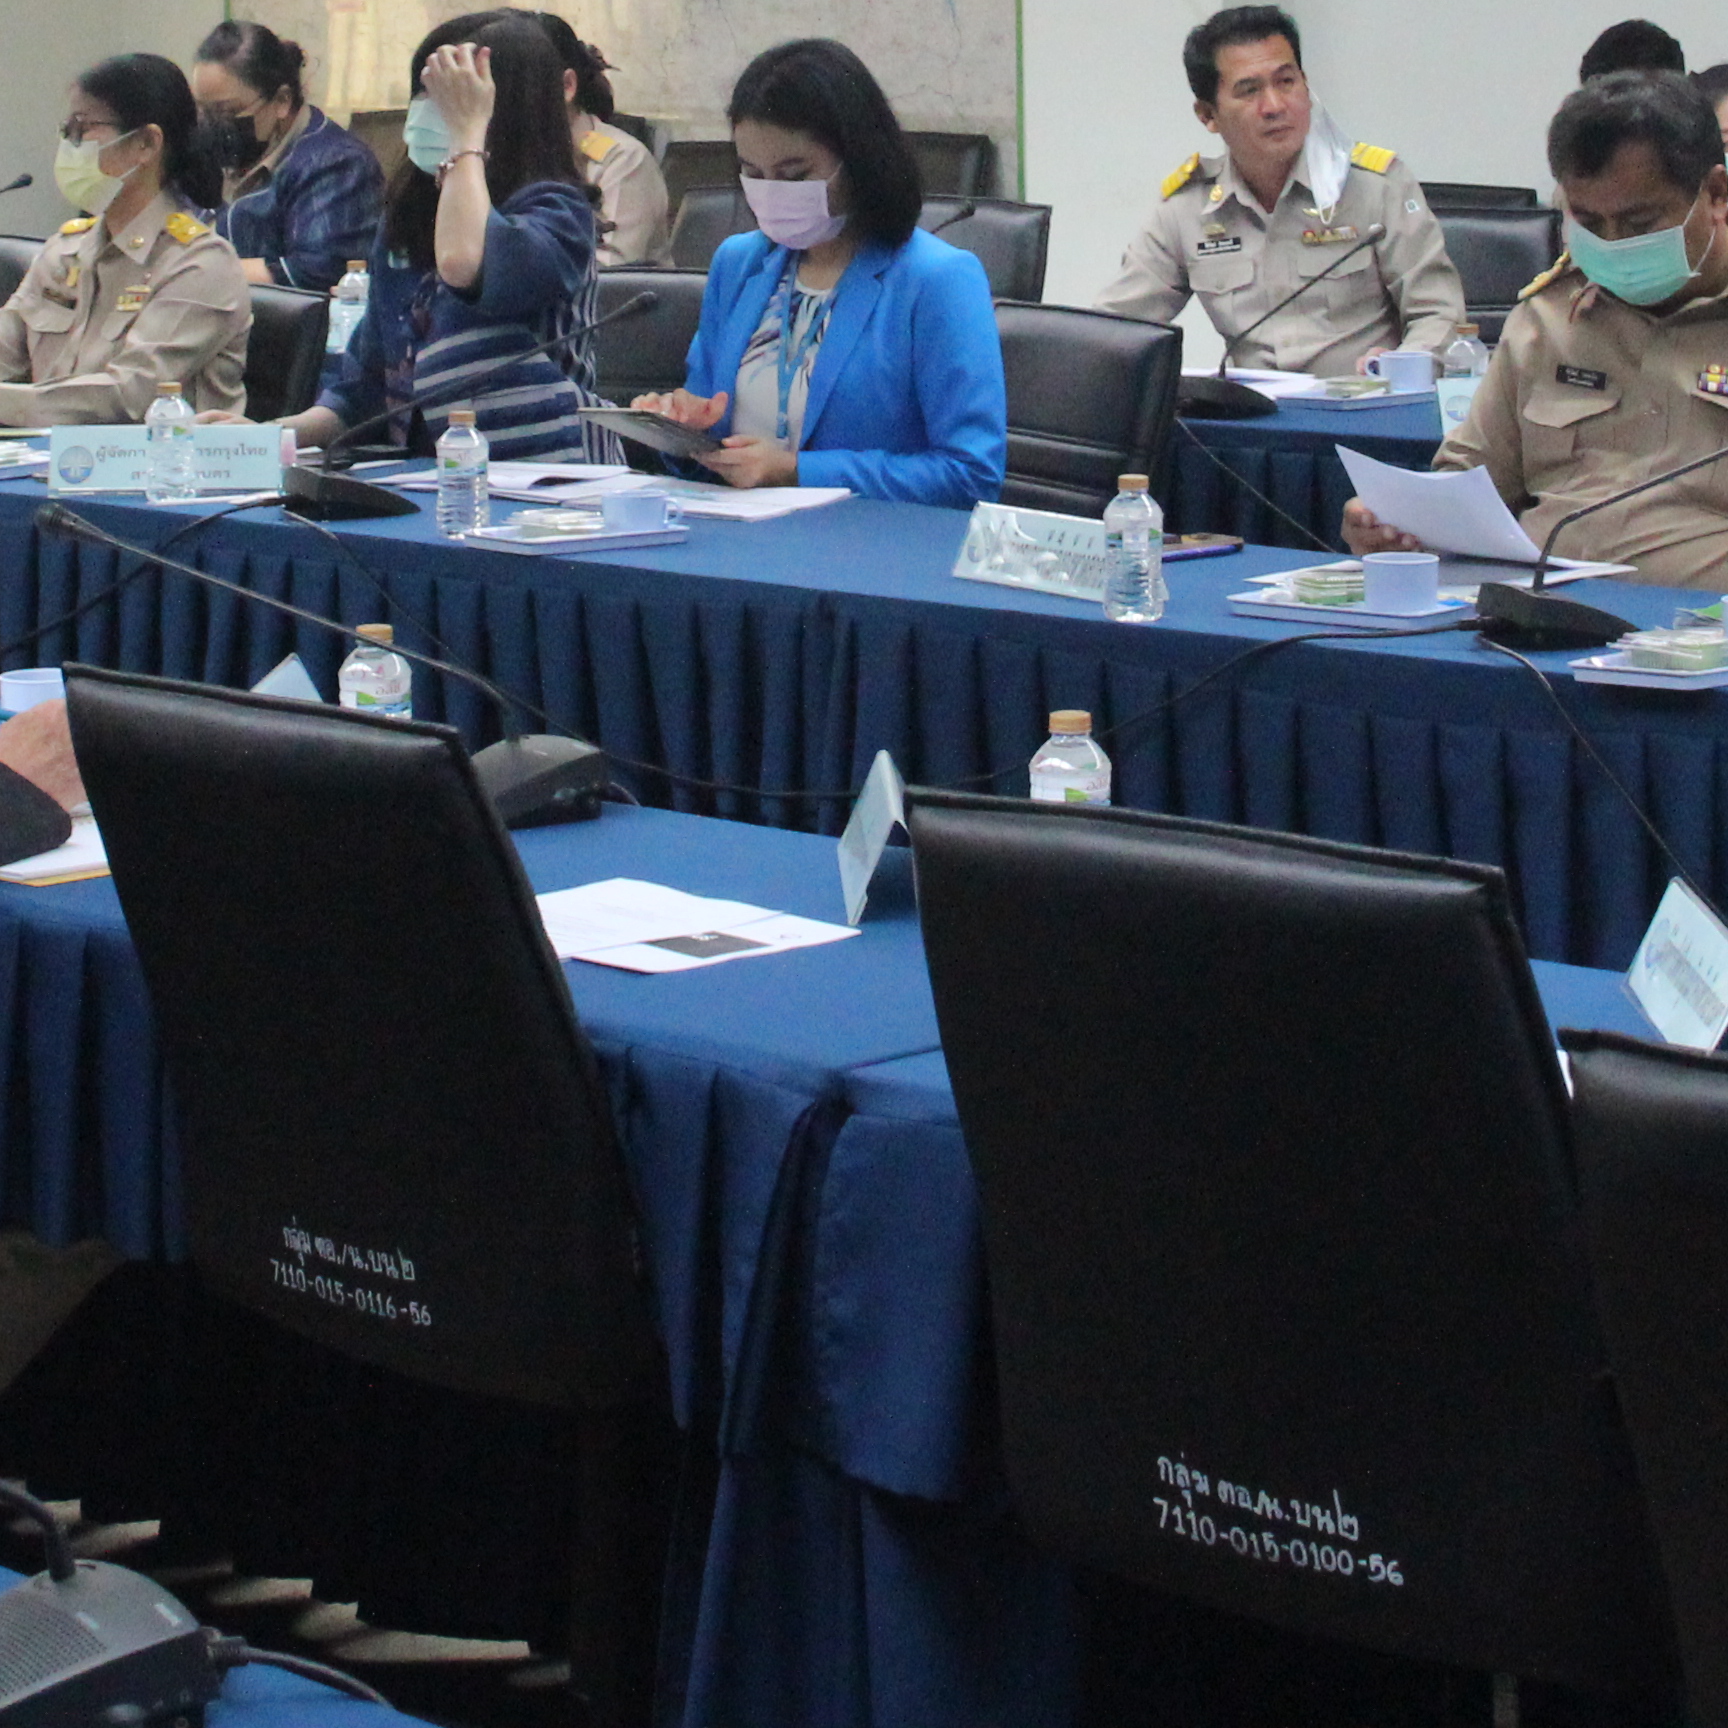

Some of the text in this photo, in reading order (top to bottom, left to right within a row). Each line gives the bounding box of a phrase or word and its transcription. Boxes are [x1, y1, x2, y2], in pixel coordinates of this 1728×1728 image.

[269, 1258, 432, 1326] 7110-015-0116-56
[1156, 1450, 1211, 1509] กลุ่ม
[1152, 1496, 1405, 1587] 7110-015-0100-56
